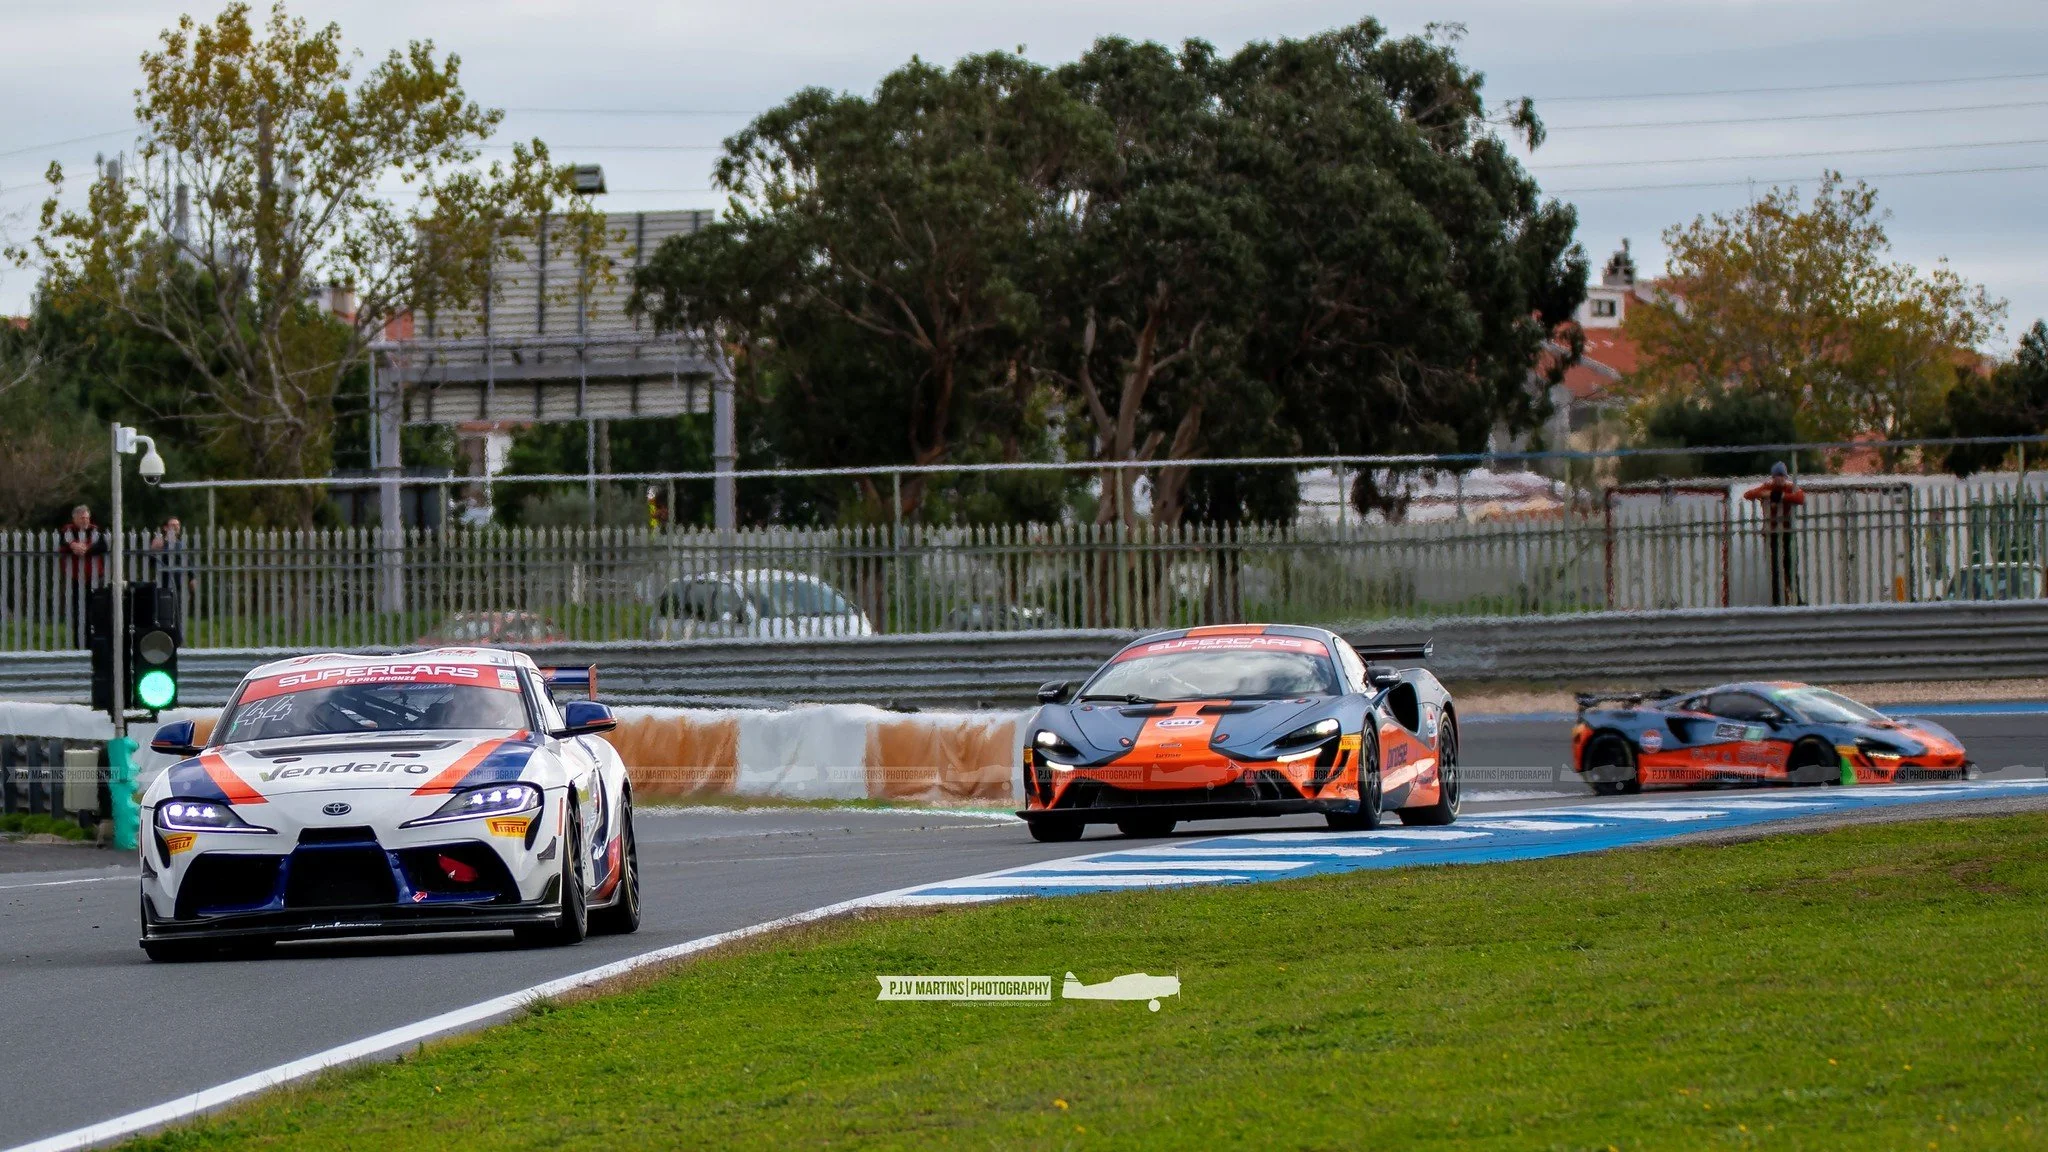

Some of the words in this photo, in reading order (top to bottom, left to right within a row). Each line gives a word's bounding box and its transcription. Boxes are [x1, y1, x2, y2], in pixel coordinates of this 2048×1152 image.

[1147, 637, 1302, 652] SUPERCARS
[278, 665, 479, 687] SUPERCARS
[336, 676, 356, 685] GT4
[235, 695, 295, 725] 44
[259, 761, 429, 783] Vendeiro
